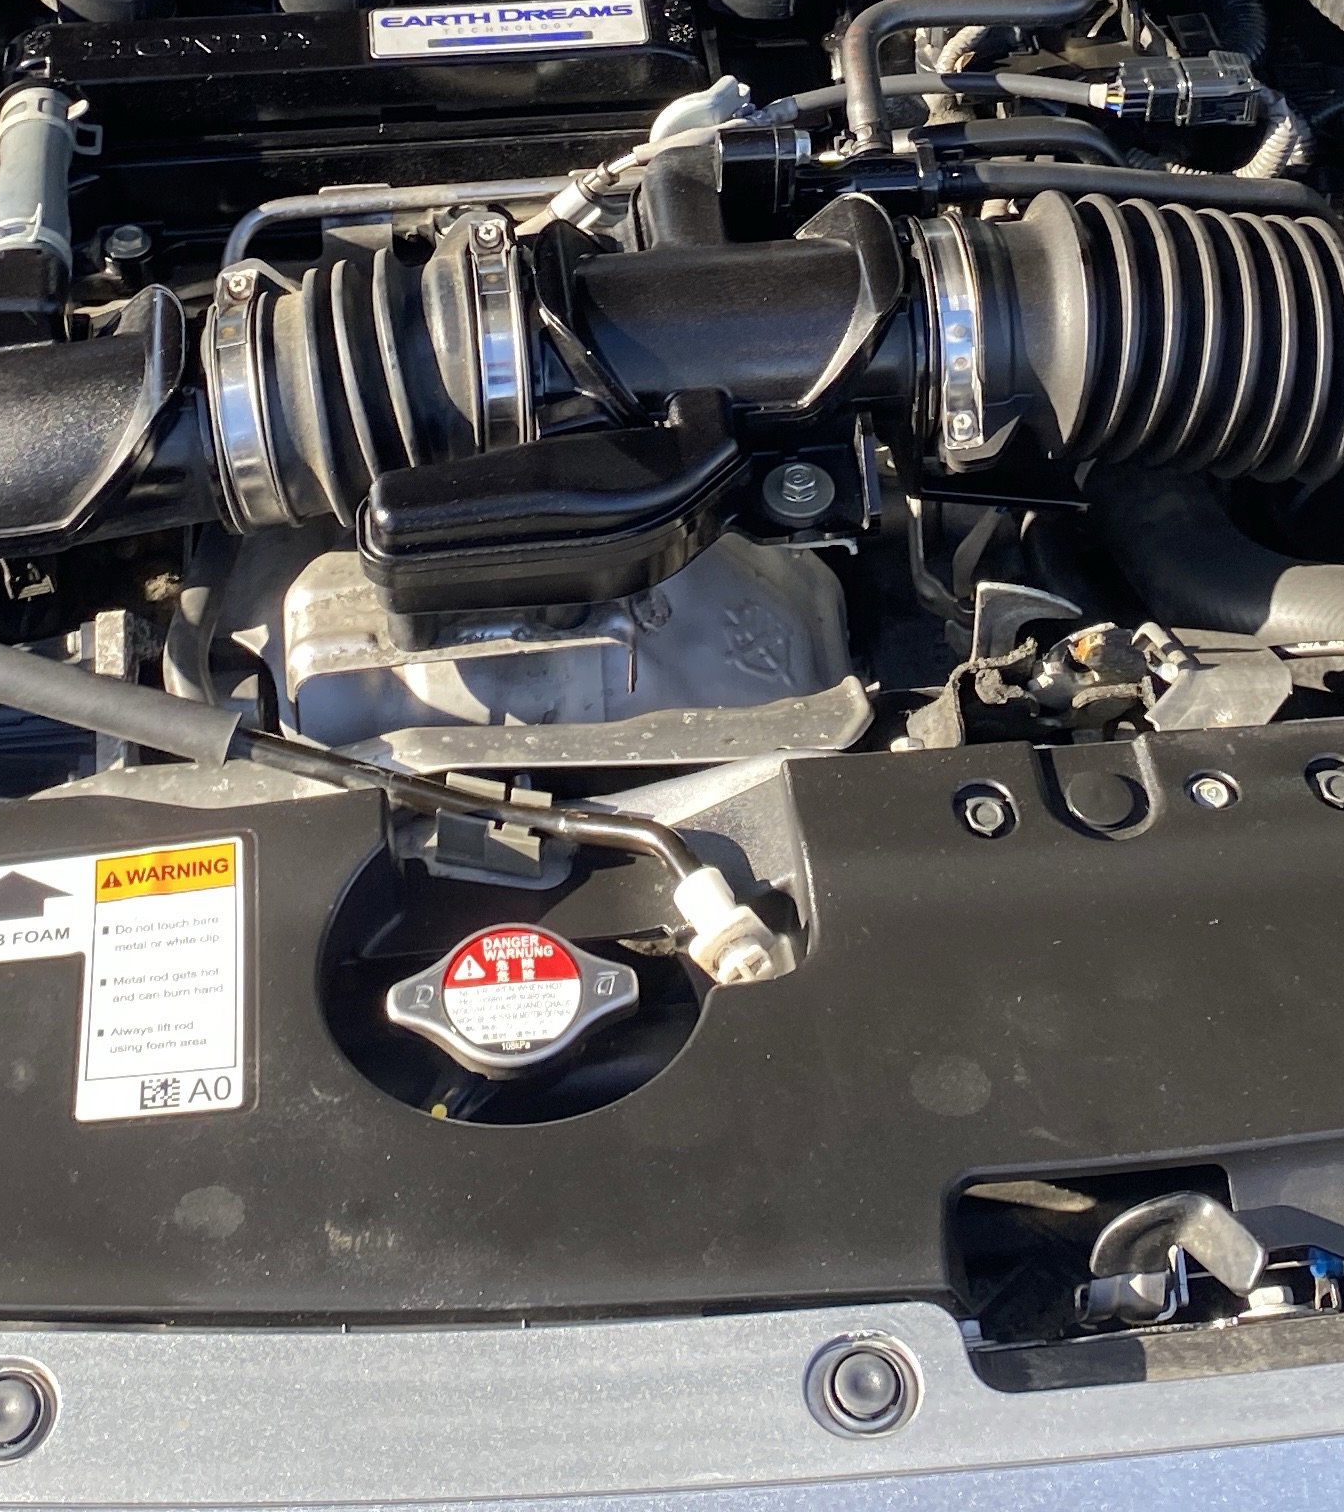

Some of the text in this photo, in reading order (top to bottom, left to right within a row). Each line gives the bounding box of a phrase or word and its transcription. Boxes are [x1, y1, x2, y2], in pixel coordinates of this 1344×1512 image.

[380, 4, 633, 28] EARTH DREAMS
[443, 22, 575, 34] TECHNOLOGY
[126, 857, 229, 886] WARNING
[12, 926, 71, 945] FOAM
[115, 924, 132, 935] Do
[136, 922, 154, 932] not
[114, 941, 147, 952] metal
[151, 940, 162, 948] or
[482, 935, 540, 950] DANGER
[483, 944, 554, 963] WARNUNG
[113, 975, 145, 986] Metal
[149, 972, 168, 982] rod
[112, 984, 224, 1003] and can burn hand
[110, 1021, 194, 1037] Always lift rod
[110, 1038, 207, 1054] using foam area
[188, 1075, 232, 1104] A0
